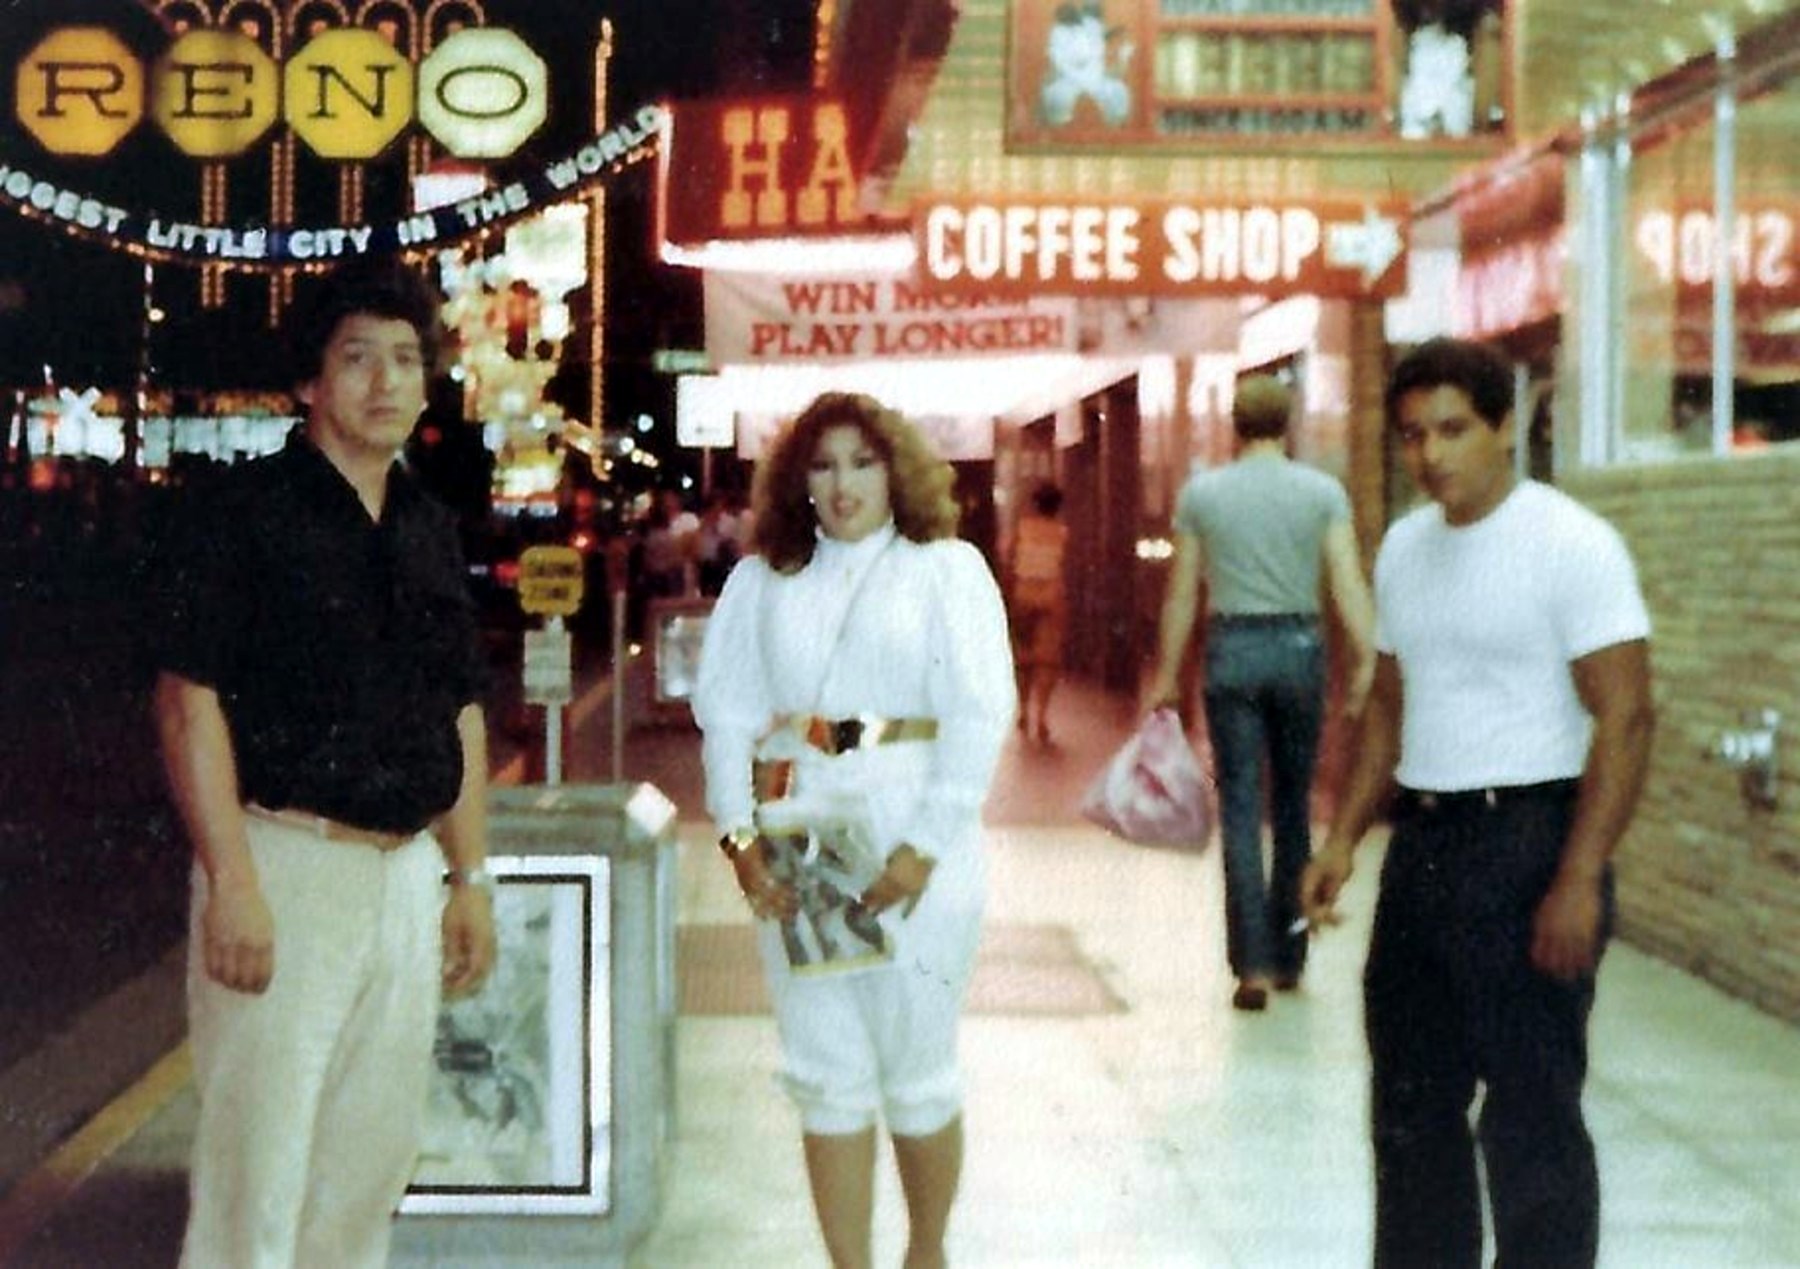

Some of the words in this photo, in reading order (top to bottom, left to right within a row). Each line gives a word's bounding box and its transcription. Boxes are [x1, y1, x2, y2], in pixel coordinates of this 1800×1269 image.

[36, 60, 529, 119] RENO
[147, 218, 268, 258] LITTLE
[288, 225, 372, 258] CITY
[397, 213, 437, 246] IN
[456, 182, 529, 228] THE
[546, 105, 666, 190] WORLD
[926, 205, 1139, 281] COFFEE
[1162, 205, 1320, 282] SHOP
[783, 281, 875, 313] WIN
[752, 322, 860, 356] PLAY
[872, 315, 1065, 355] LONGER!
